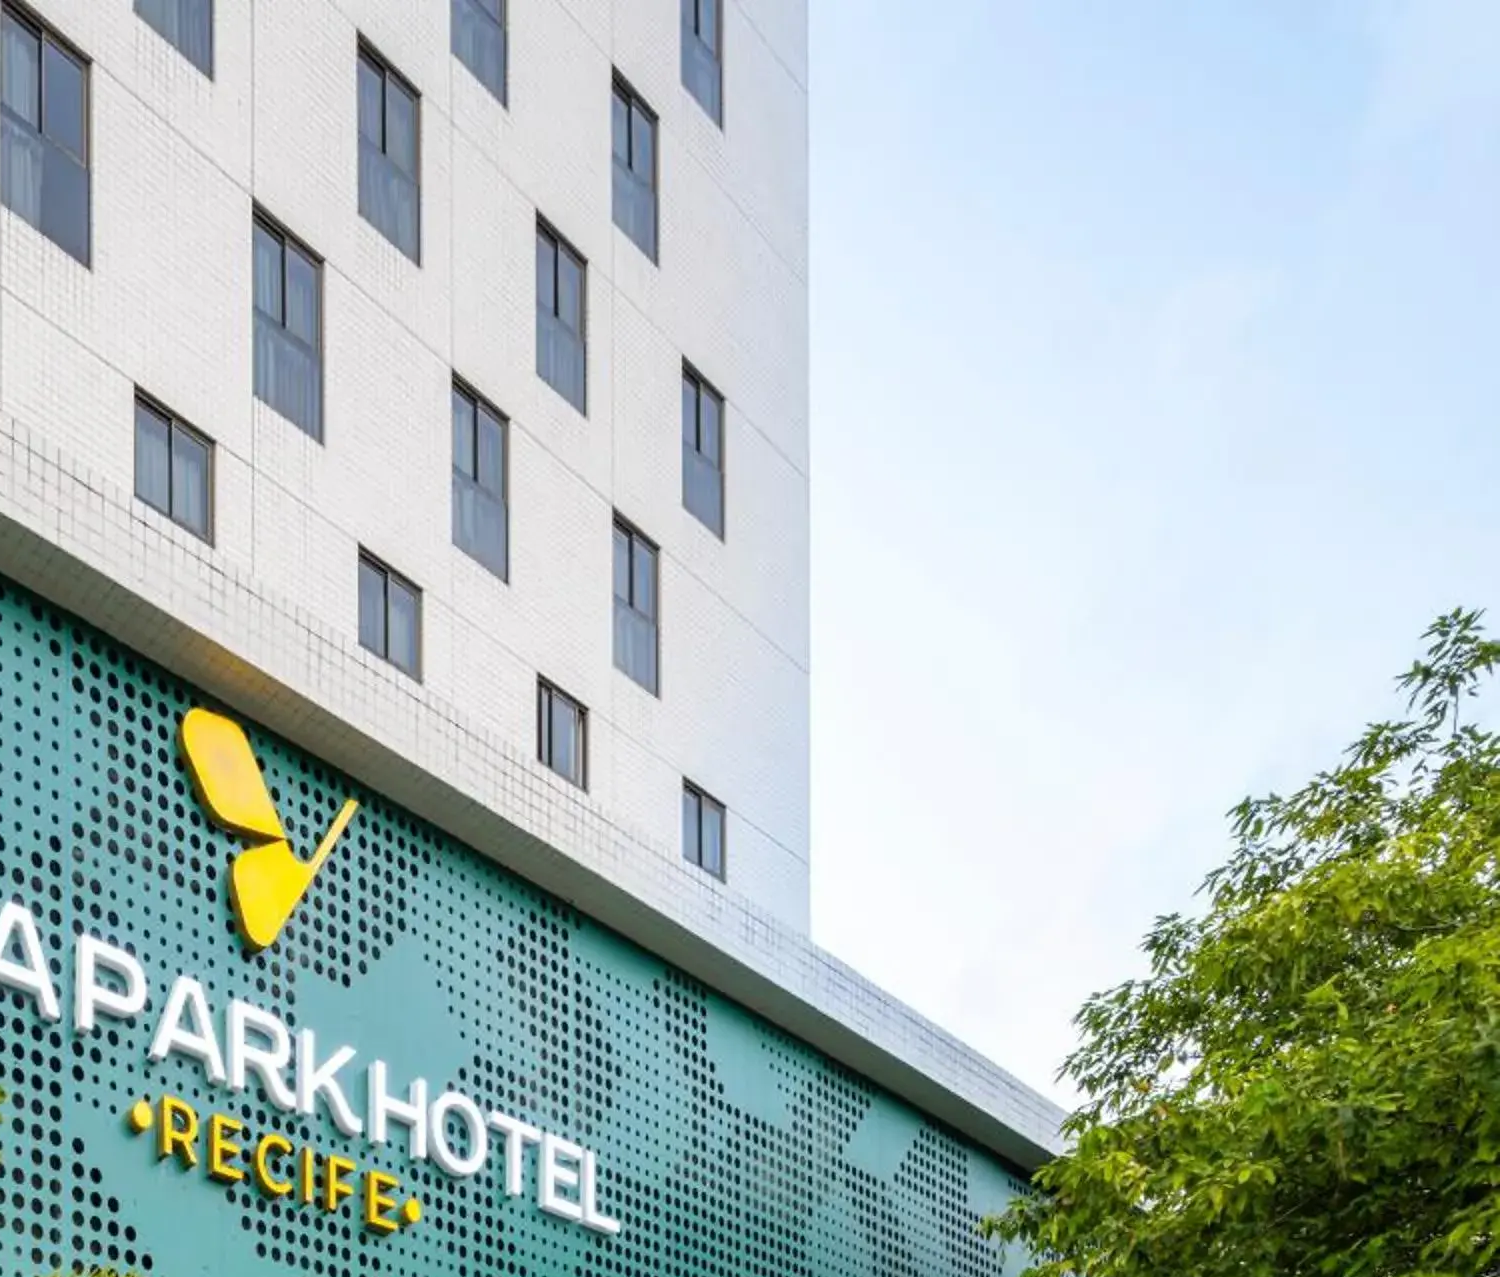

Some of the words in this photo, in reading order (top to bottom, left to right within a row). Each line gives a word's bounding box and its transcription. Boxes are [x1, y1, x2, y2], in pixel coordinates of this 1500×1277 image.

[74, 934, 363, 1138] PARK
[367, 1059, 621, 1235] HOTEL
[156, 1094, 401, 1236] RECIFE
